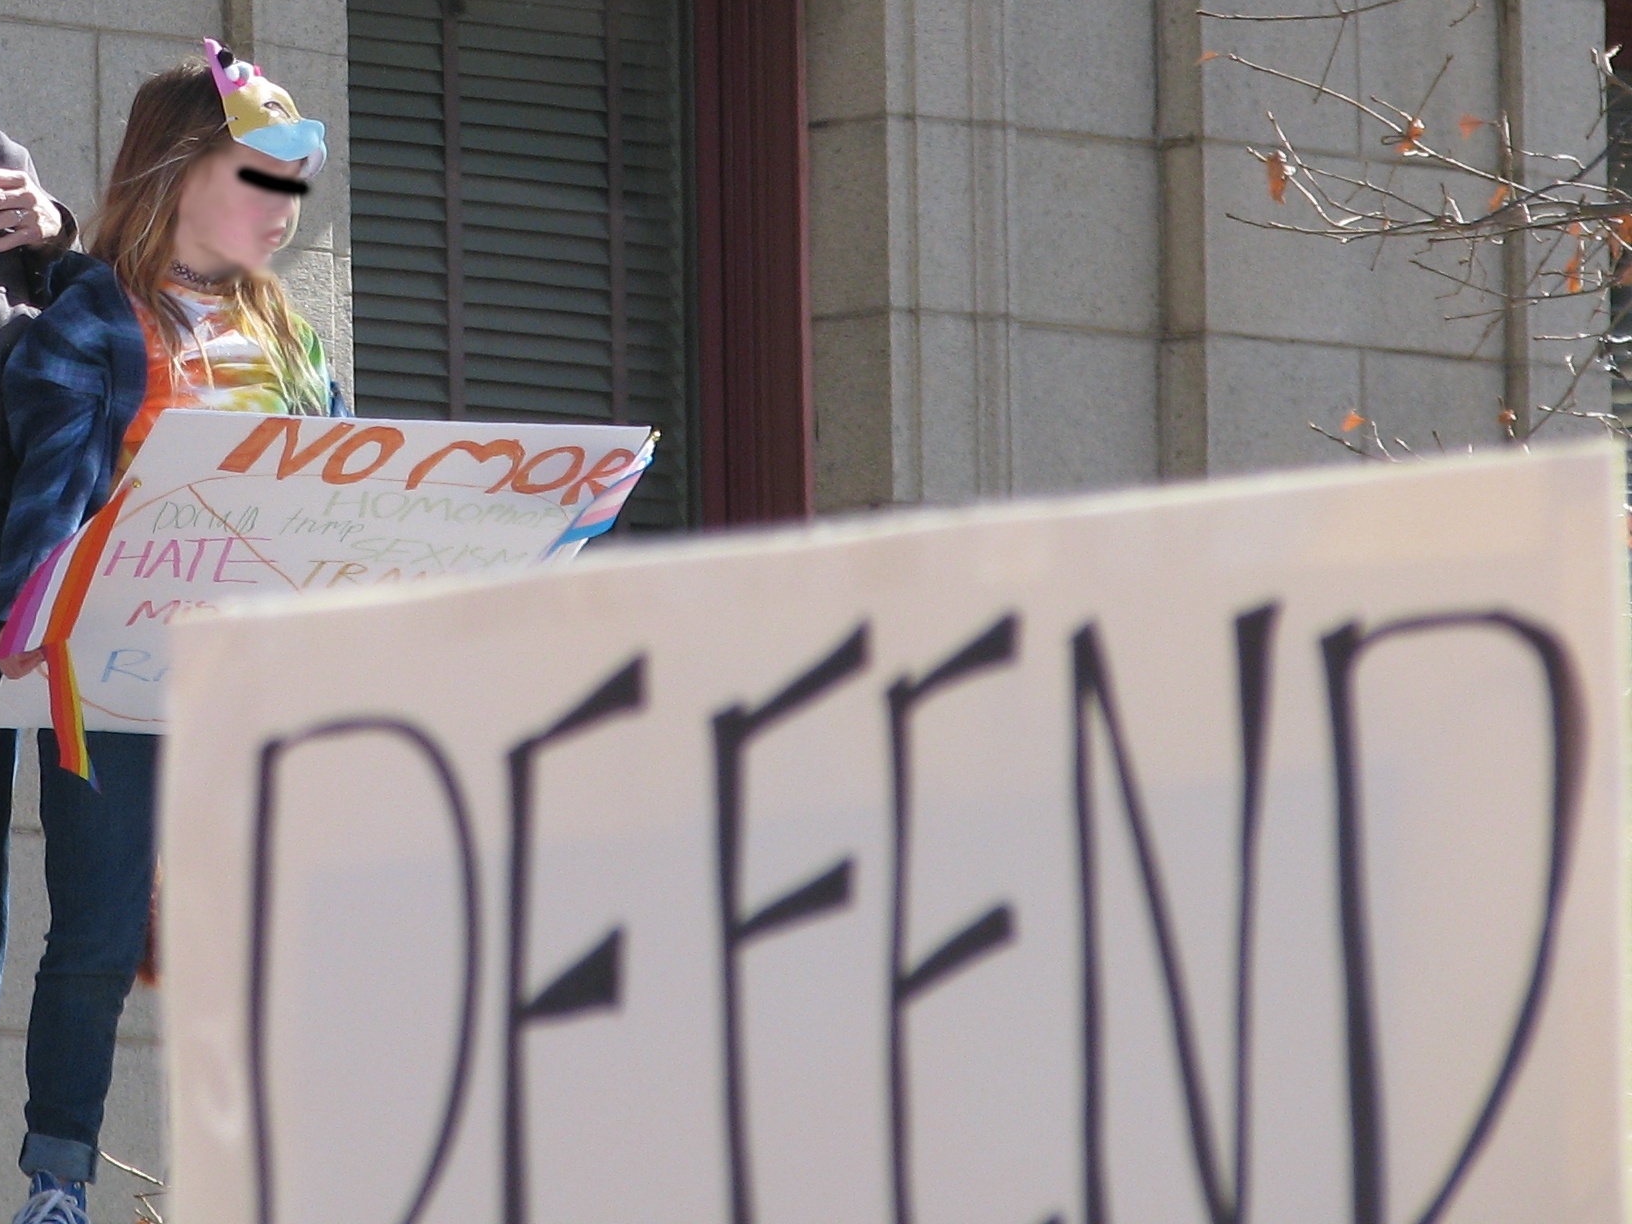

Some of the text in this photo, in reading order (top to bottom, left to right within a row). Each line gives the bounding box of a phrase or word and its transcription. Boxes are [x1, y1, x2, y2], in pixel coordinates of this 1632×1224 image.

[217, 417, 406, 486] NO
[102, 536, 279, 584] HATE
[248, 599, 1590, 1224] DEFEND
